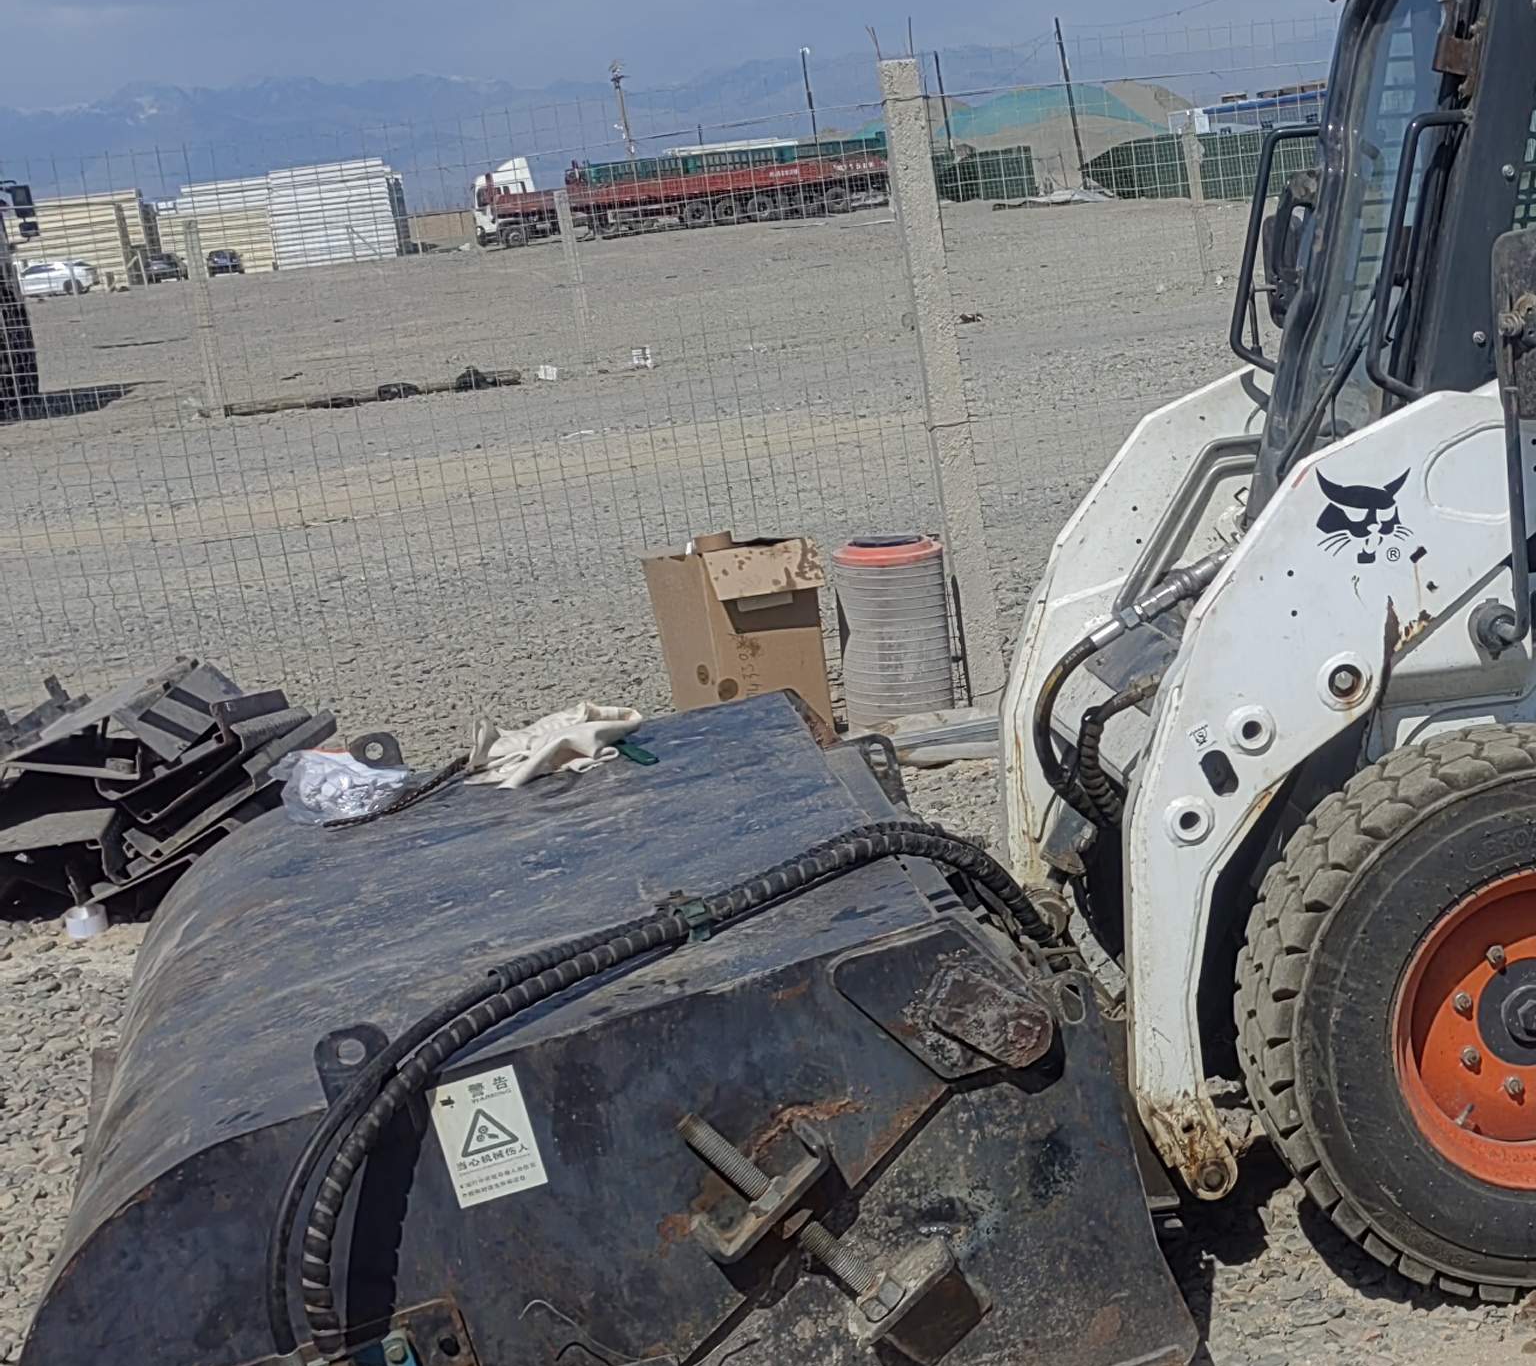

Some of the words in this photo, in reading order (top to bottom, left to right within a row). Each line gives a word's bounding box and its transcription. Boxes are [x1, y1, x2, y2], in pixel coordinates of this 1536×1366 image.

[467, 1076, 508, 1099] 警告
[456, 1143, 529, 1172] 当心机械伤人
